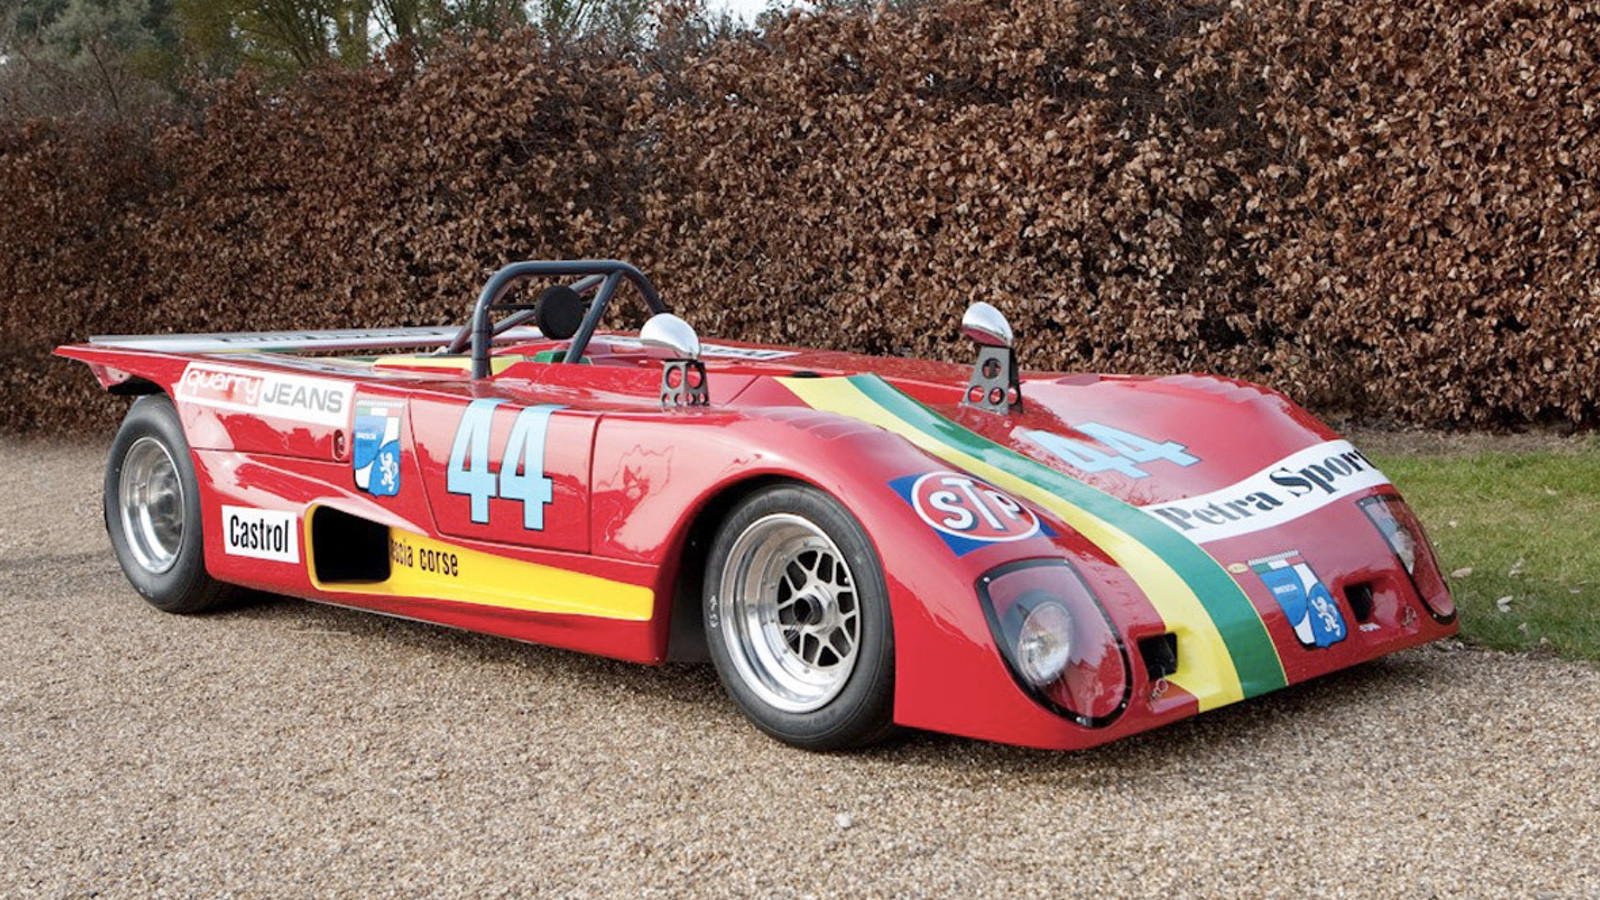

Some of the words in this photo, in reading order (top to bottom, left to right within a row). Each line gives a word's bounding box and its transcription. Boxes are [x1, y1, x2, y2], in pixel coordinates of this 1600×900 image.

[187, 369, 261, 407] quarry
[264, 382, 344, 413] JEANS
[446, 397, 568, 531] 44
[1009, 421, 1202, 479] 44
[929, 477, 1021, 531] STP
[1153, 491, 1284, 532] Petra
[230, 514, 289, 554] Castrol
[420, 548, 458, 577] corse
